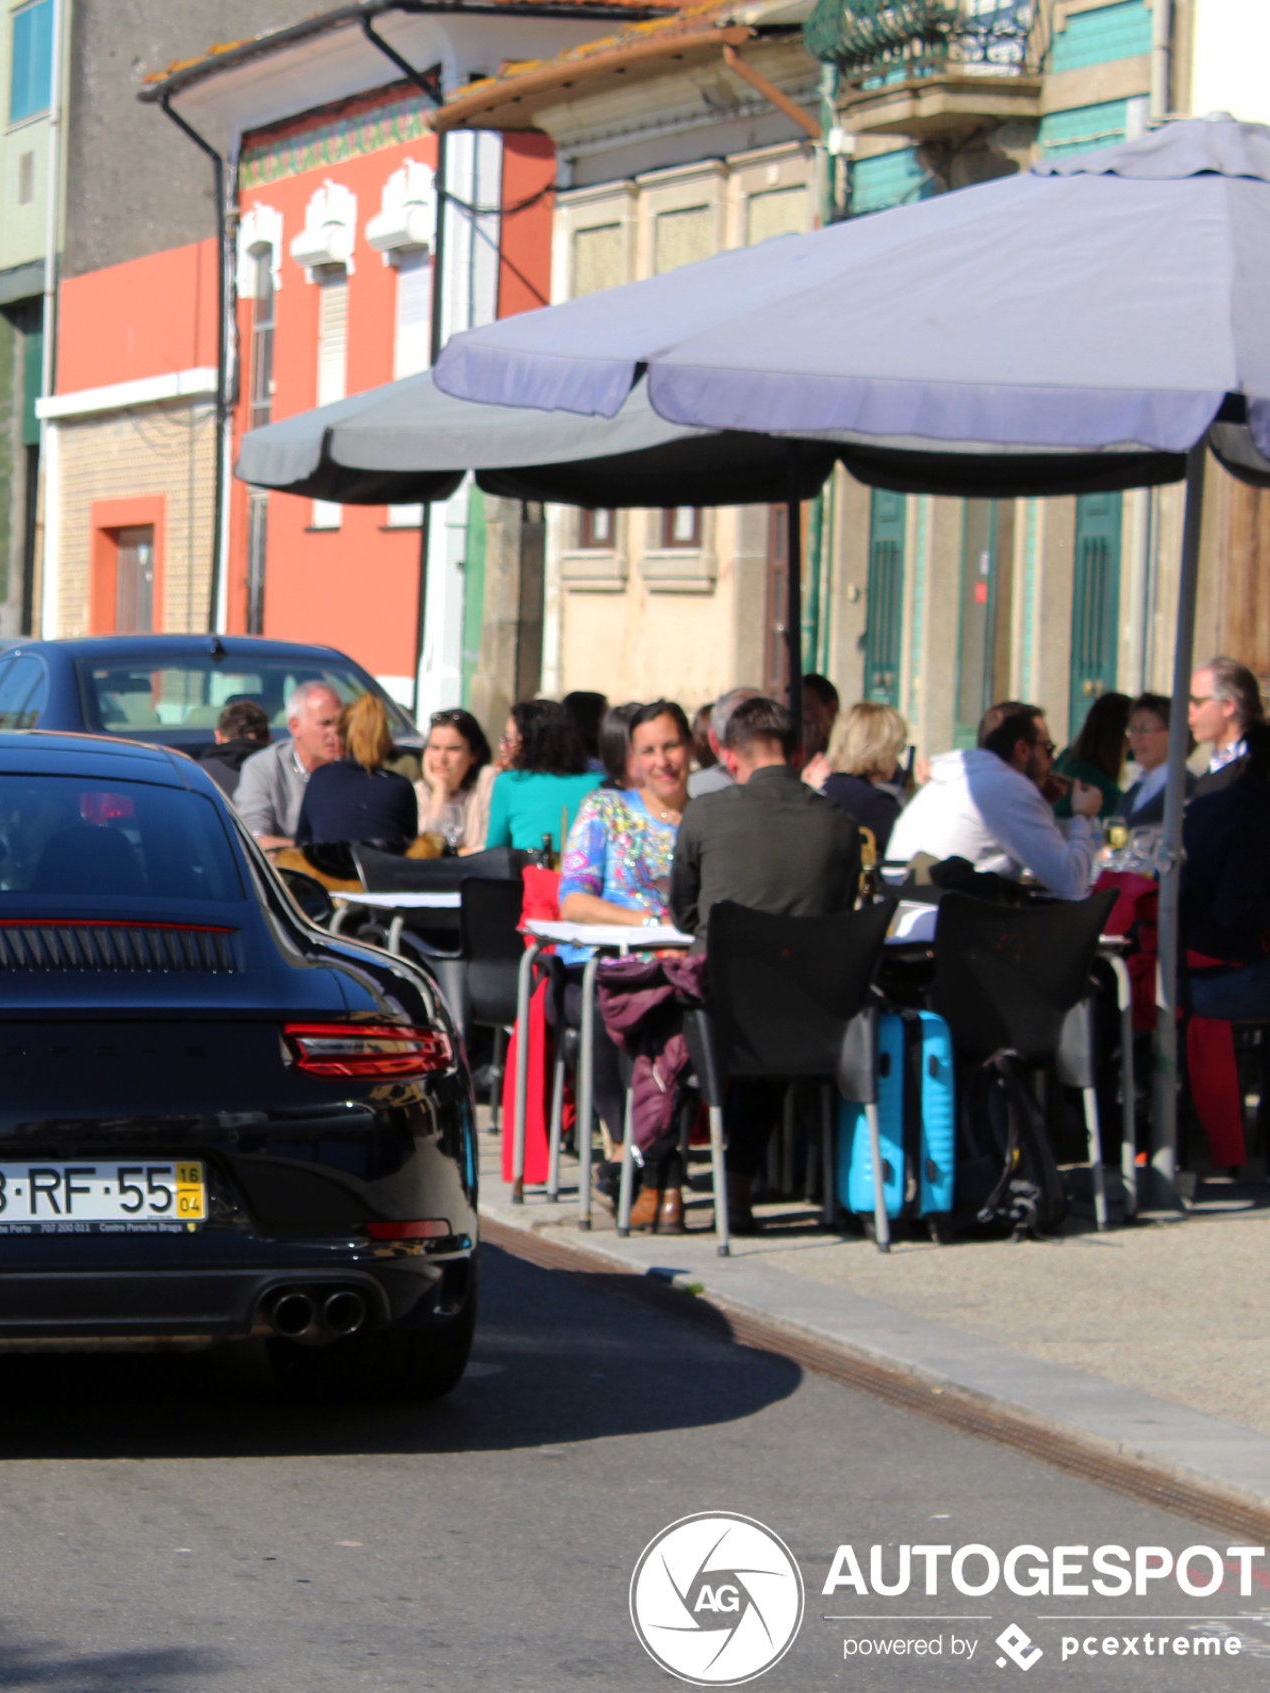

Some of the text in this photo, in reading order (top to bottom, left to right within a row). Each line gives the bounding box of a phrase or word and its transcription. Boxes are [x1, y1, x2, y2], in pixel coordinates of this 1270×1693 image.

[179, 1168, 199, 1183] 16
[179, 1197, 200, 1212] 04
[10, 1225, 32, 1233] Porto
[40, 1224, 56, 1233] 707
[127, 1223, 158, 1232] Porsche
[159, 1222, 183, 1233] Braga
